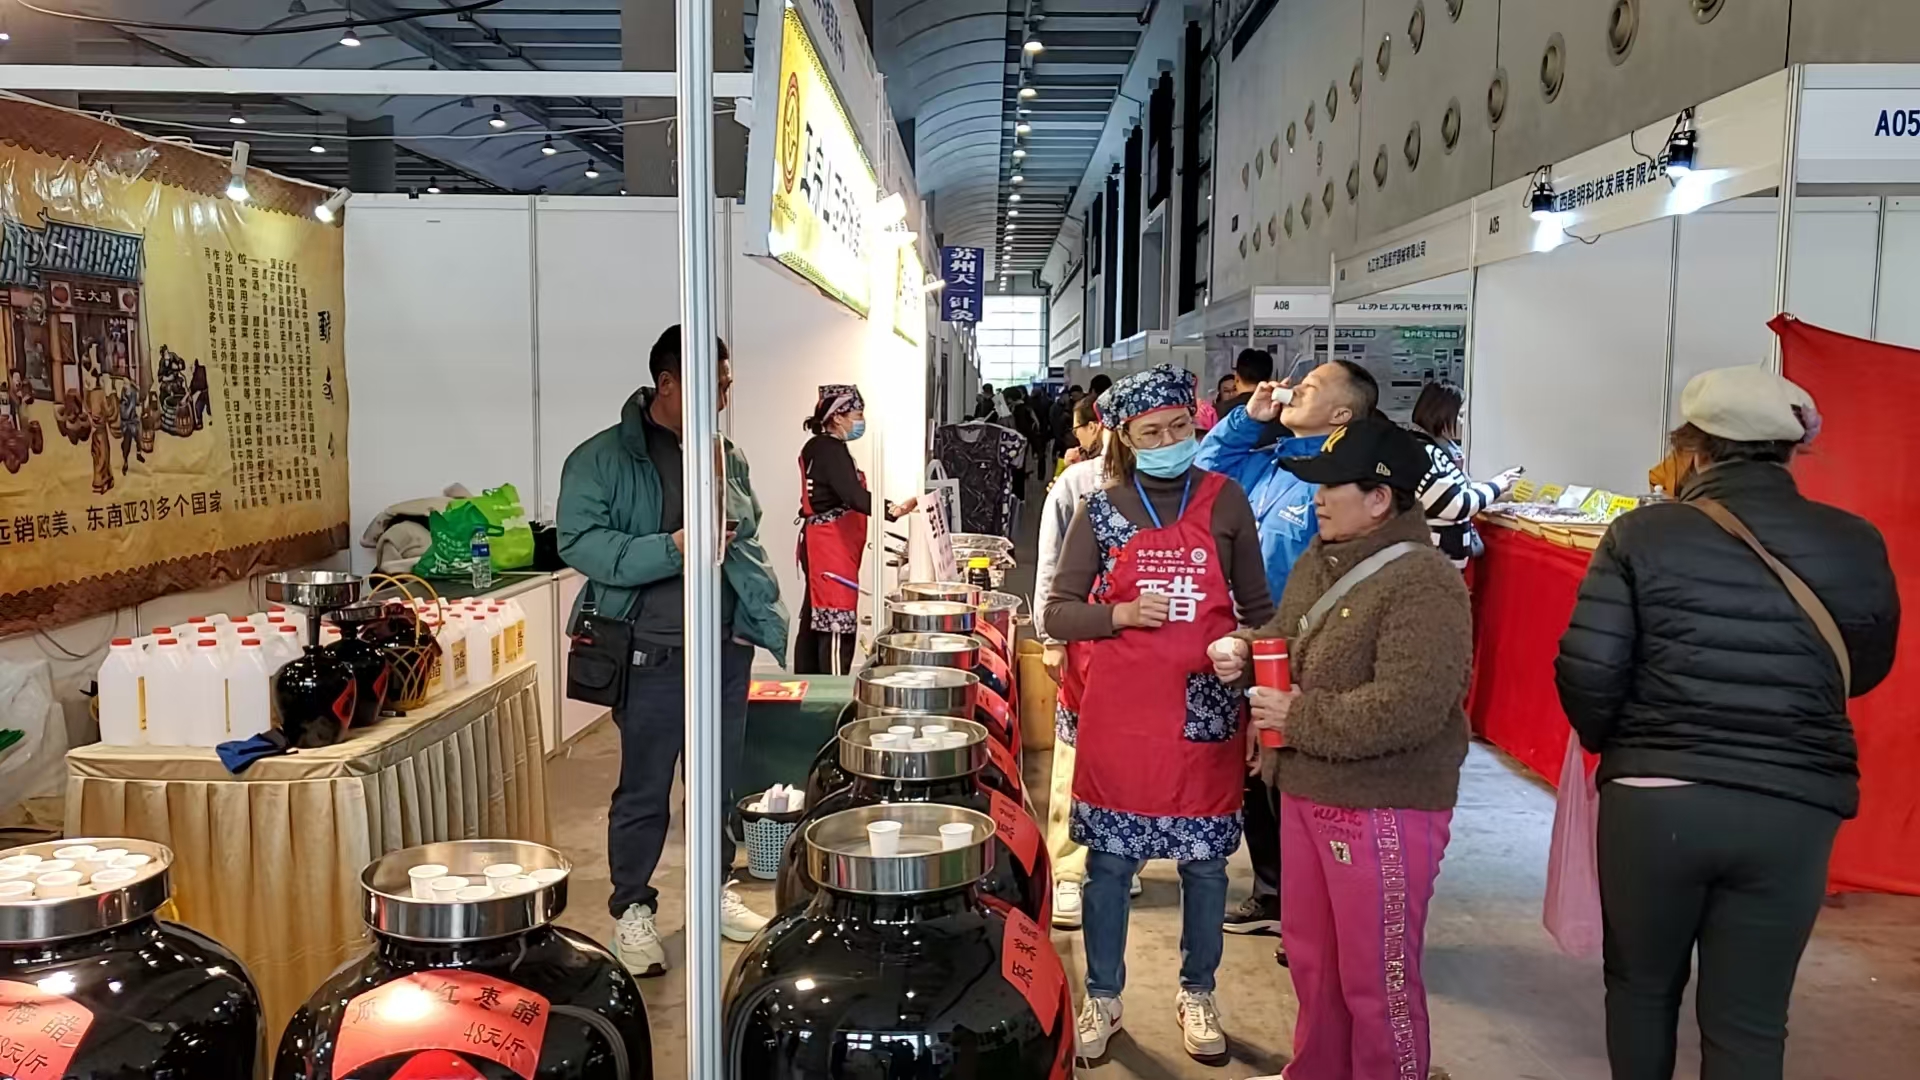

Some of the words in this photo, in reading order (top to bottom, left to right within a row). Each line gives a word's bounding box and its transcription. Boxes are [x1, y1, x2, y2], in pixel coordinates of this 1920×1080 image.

[1874, 109, 1920, 137] A05
[1489, 216, 1500, 235] A05
[949, 247, 977, 321] 苏州天一针灸
[1273, 300, 1290, 311] A08
[352, 981, 542, 1027] 原红枣醋
[463, 1021, 527, 1058] 48元/斤
